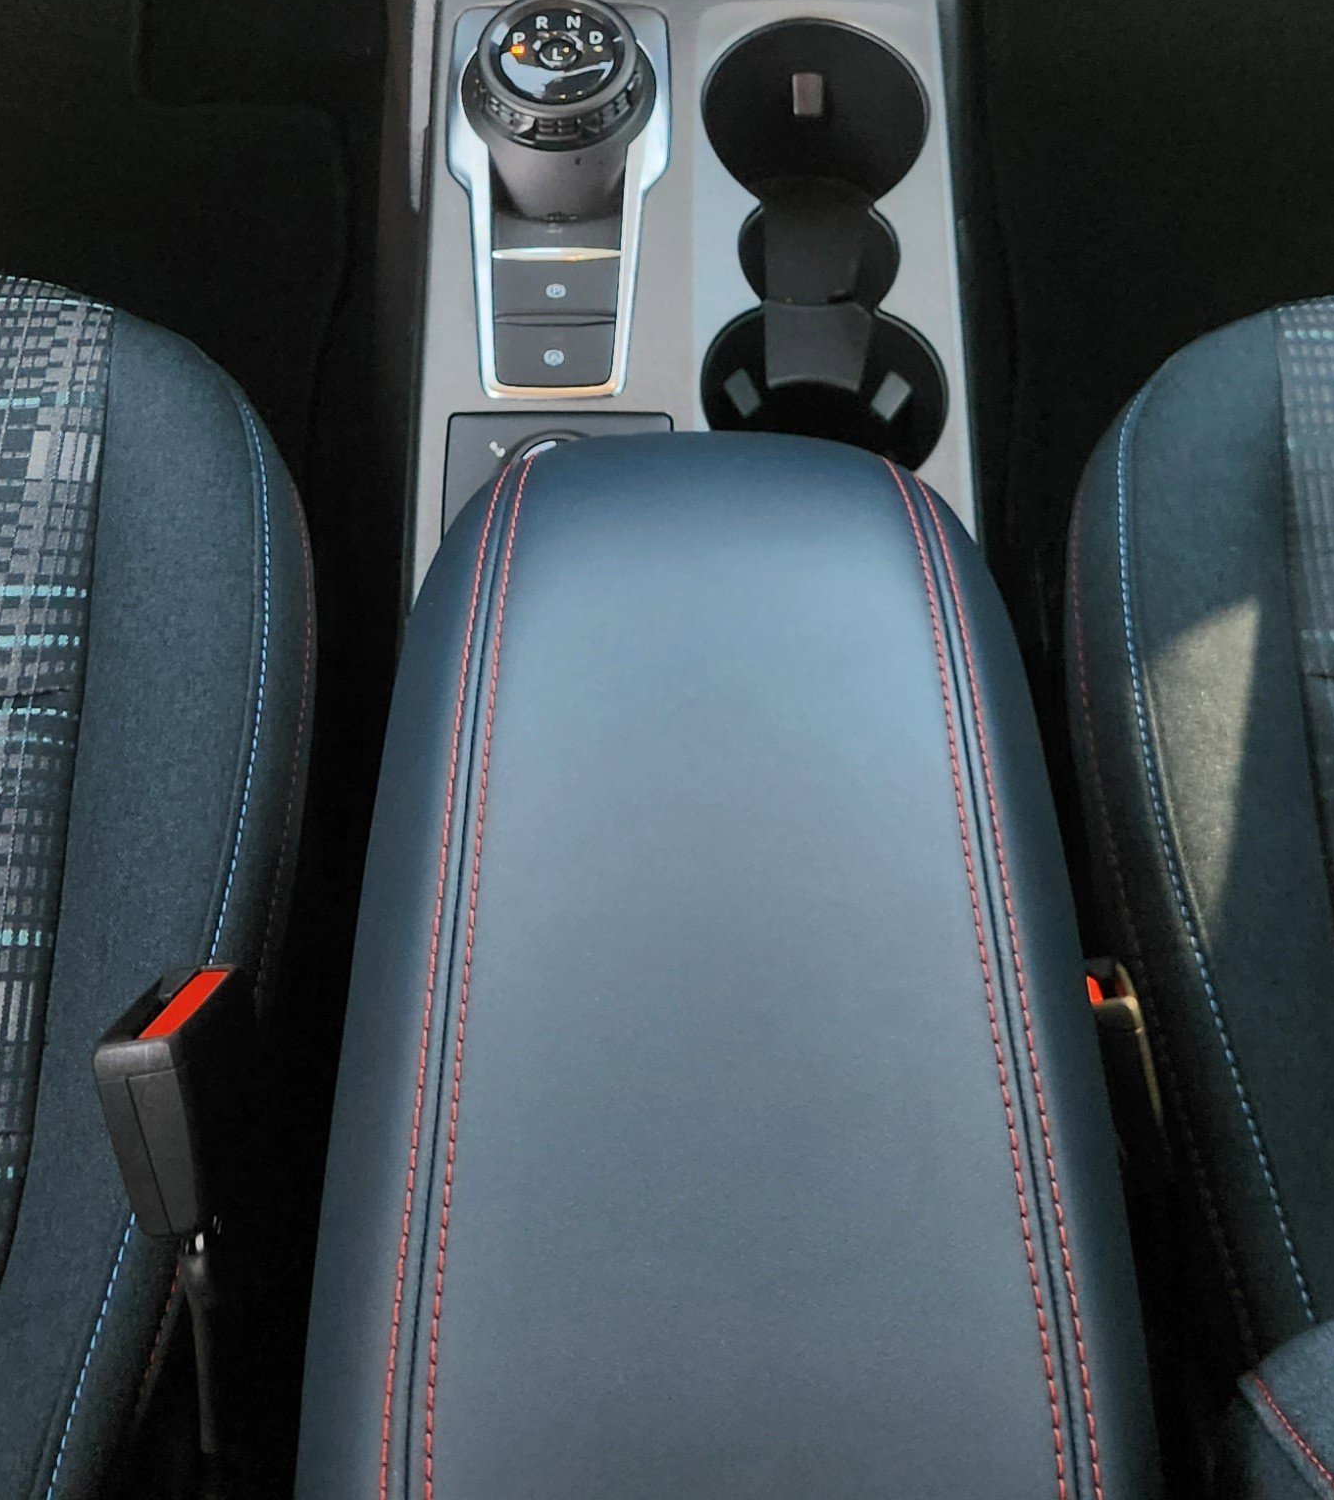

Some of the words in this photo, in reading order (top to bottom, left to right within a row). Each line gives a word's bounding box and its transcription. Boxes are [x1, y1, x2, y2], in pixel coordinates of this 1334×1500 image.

[536, 16, 549, 28] R
[567, 16, 581, 28] N
[512, 32, 526, 44] P
[589, 31, 604, 44] D
[552, 48, 563, 60] L
